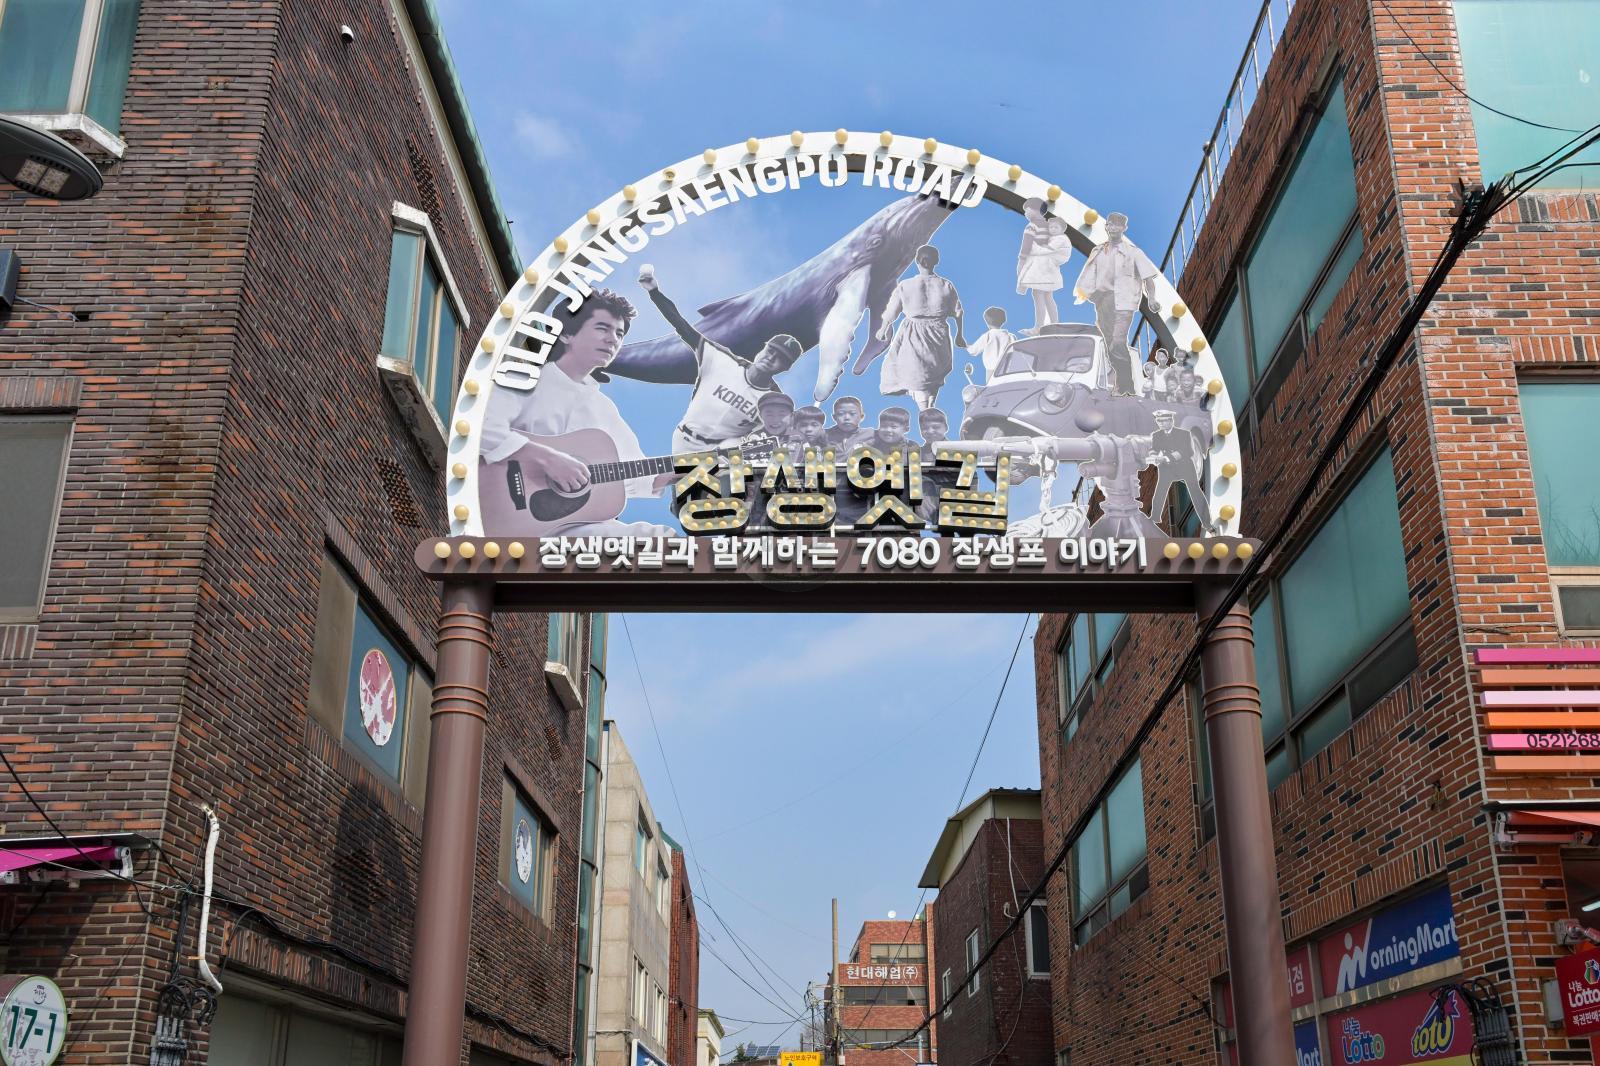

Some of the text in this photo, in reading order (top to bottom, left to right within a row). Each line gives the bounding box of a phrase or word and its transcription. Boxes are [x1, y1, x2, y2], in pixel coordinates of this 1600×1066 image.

[492, 153, 988, 390] OLD JANGSAENGPO ROAD
[712, 385, 759, 420] KOREA
[673, 447, 1012, 532] 장생옛길
[539, 535, 1147, 569] 장생옛길과 함께하는 7080 장생포 이야기
[847, 966, 918, 980] 현대해업(주)
[8, 1005, 57, 1053] 17-1
